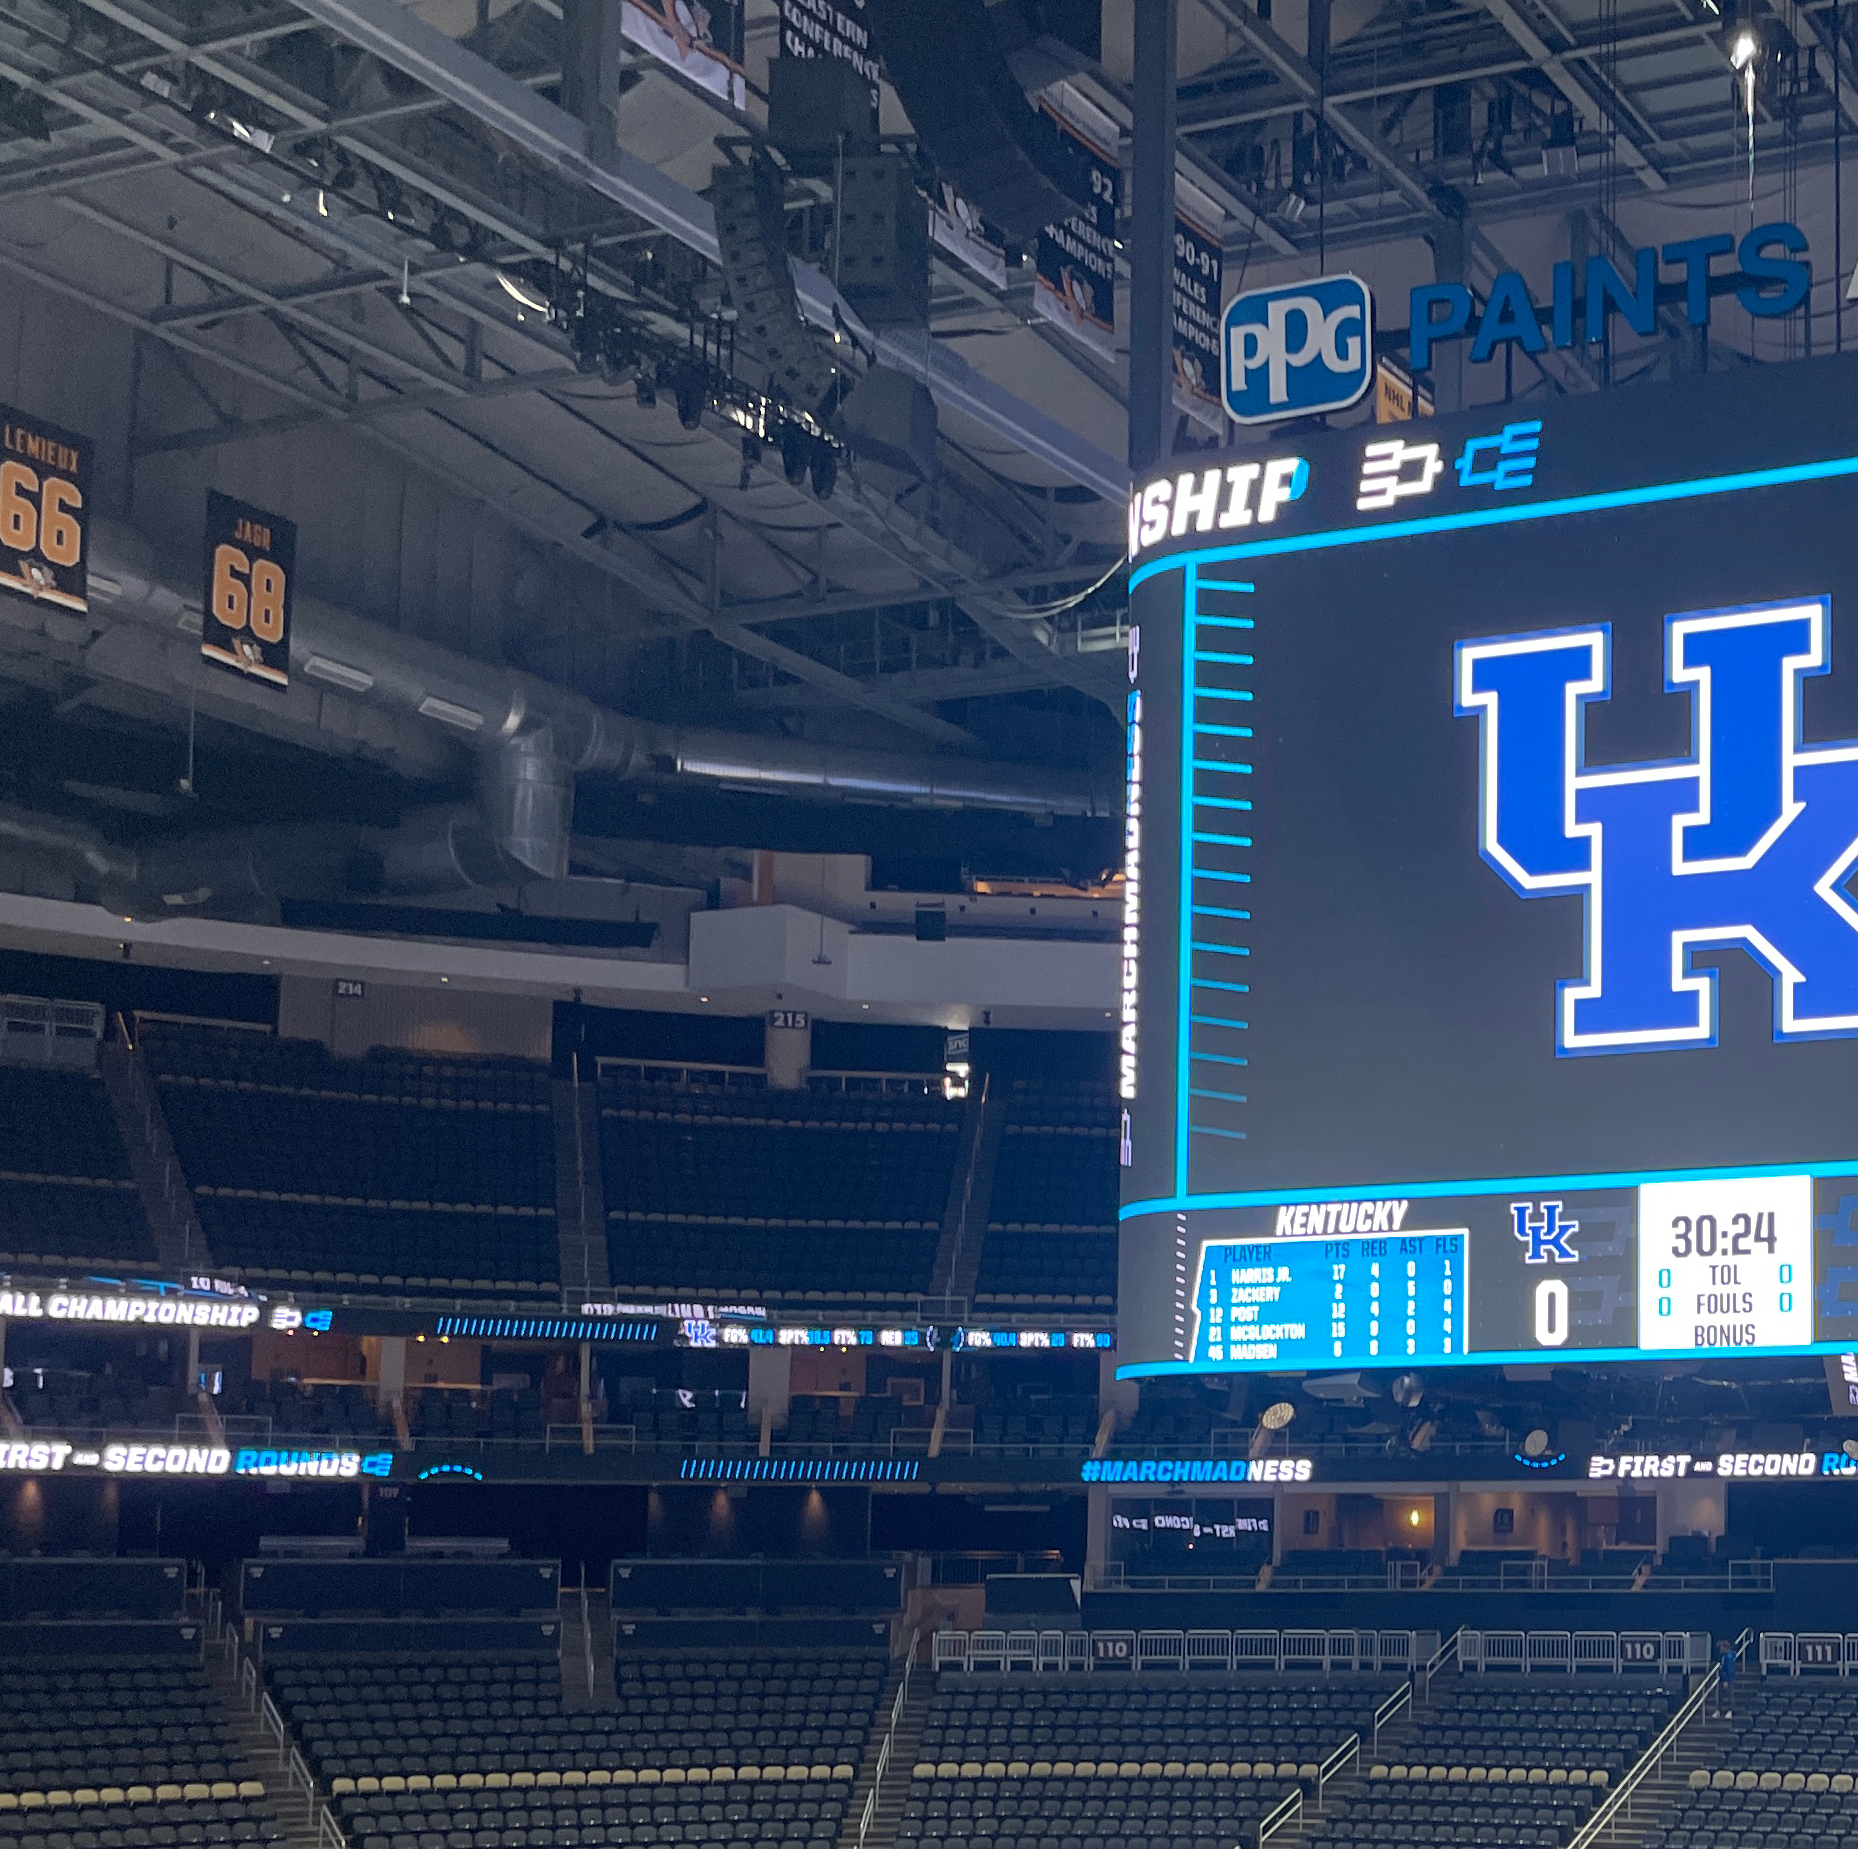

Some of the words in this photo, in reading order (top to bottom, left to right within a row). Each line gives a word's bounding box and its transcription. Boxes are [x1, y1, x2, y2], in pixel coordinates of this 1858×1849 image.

[1230, 297, 1363, 405] PPG
[1409, 222, 1811, 372] PAINTS
[4, 424, 79, 474] LEMIEUX
[0, 460, 83, 568] 66
[212, 543, 286, 644] 68
[773, 1012, 806, 1028] 215
[1275, 1199, 1410, 1237] KENTUCKY
[1671, 1211, 1778, 1259] 30:24
[1223, 1245, 1272, 1263] PLAYER
[1324, 1241, 1350, 1260] PTS
[1361, 1240, 1388, 1258] REB
[1400, 1237, 1424, 1256] AST
[1435, 1236, 1459, 1255] FLS
[1210, 1269, 1217, 1286] 1
[1332, 1263, 1346, 1281] 17
[1407, 1260, 1416, 1278] 0
[1444, 1259, 1452, 1276] 1
[1658, 1268, 1672, 1289] 0
[1709, 1263, 1742, 1287] TOL
[1778, 1263, 1793, 1285] 0
[1231, 1286, 1281, 1304] ZACKERY
[1443, 1278, 1452, 1296] 0
[1658, 1296, 1672, 1317] 0
[1696, 1292, 1754, 1315] FOULS
[1778, 1291, 1793, 1313] 0
[49, 1293, 261, 1328] CHAMPIONSHIP
[1230, 1305, 1260, 1323] POST
[1331, 1302, 1346, 1319] 12
[1534, 1278, 1570, 1347] 0
[1694, 1323, 1757, 1348] BONUS
[104, 1446, 232, 1475] SECOND
[234, 1449, 361, 1477] ROUNDS
[1081, 1458, 1313, 1483] #MARCHMADNESS
[1617, 1453, 1693, 1479] FIRST
[1717, 1451, 1816, 1477] SECOND
[1096, 1641, 1128, 1658] 110
[1625, 1642, 1655, 1660] 110
[1806, 1644, 1833, 1662] 111
